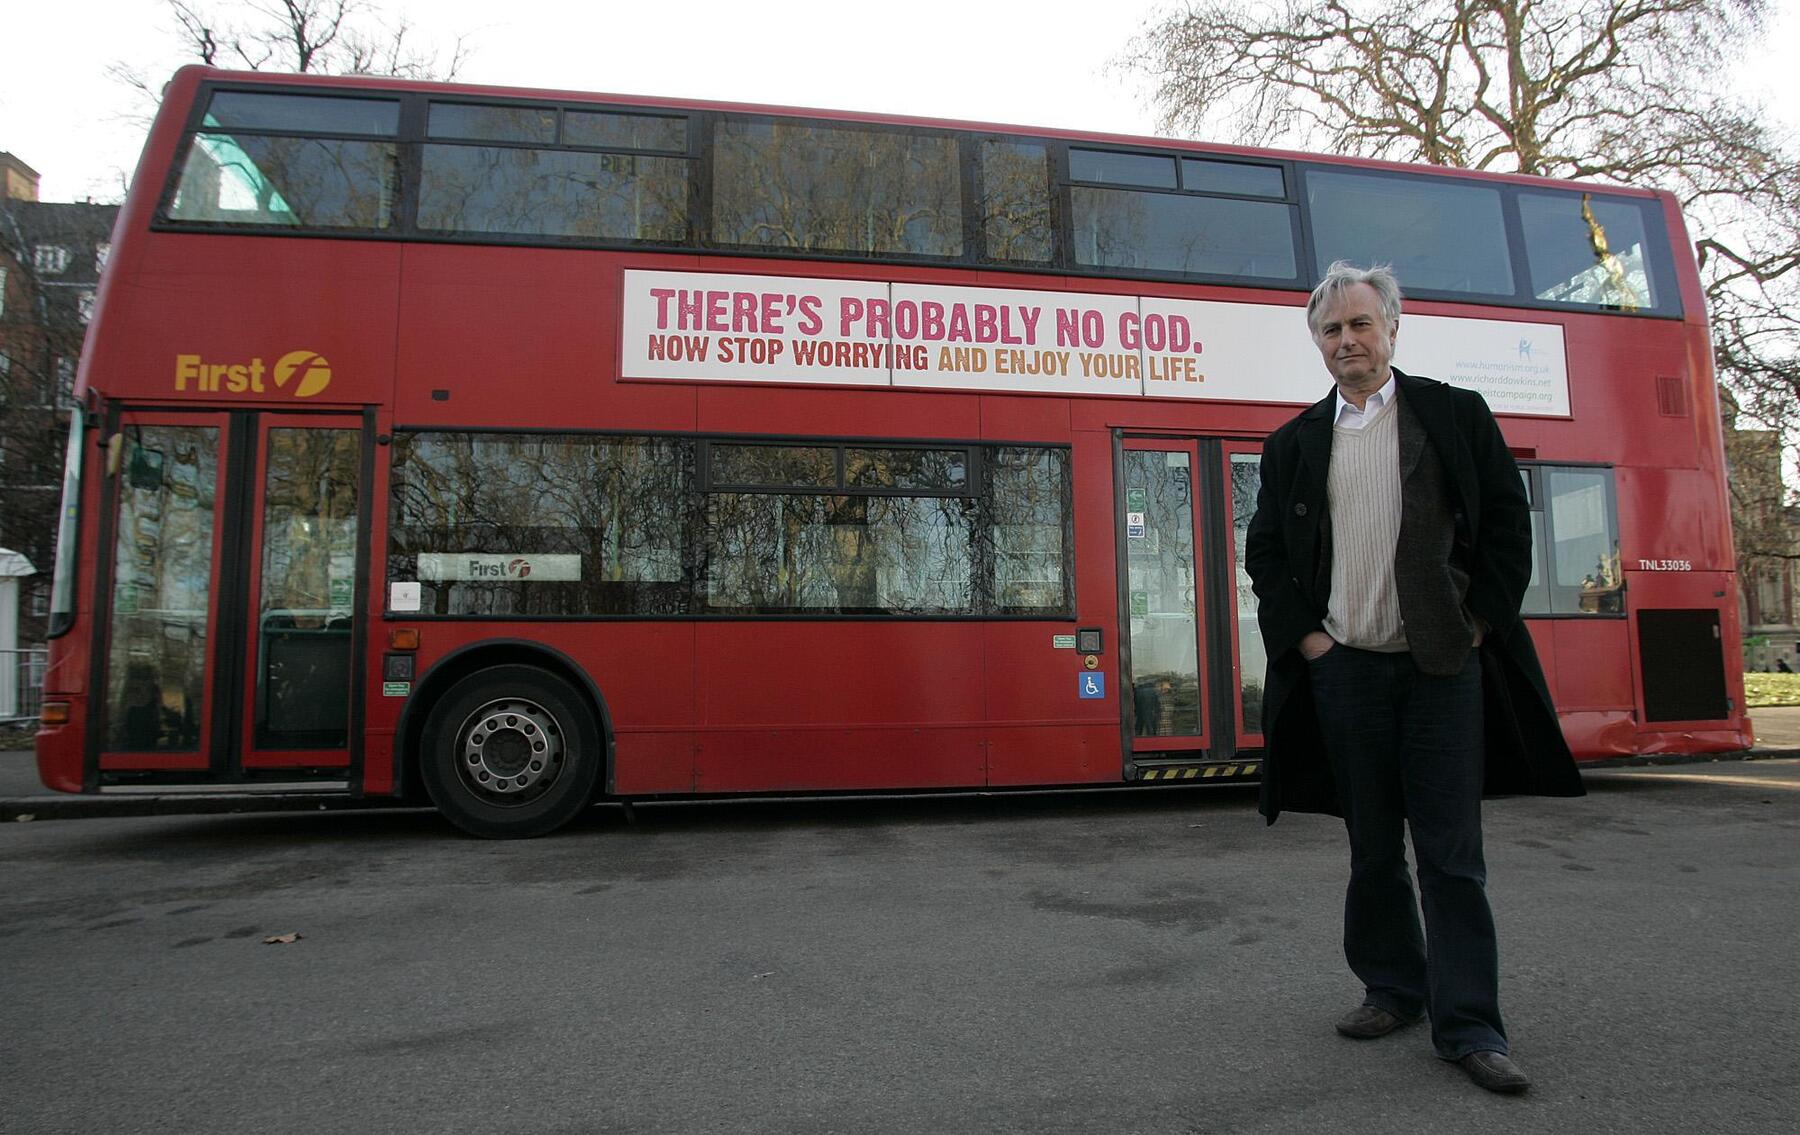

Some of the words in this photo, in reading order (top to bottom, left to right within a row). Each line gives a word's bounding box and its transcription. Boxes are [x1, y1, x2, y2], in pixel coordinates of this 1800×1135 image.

[649, 288, 824, 337] THERE'S
[839, 297, 1042, 345] PROBABLY
[1055, 307, 1105, 349] NO
[1118, 311, 1204, 355] GOD.
[174, 354, 266, 393] First
[648, 333, 710, 363] NOW
[717, 336, 784, 365] STOP
[792, 339, 929, 371] WORRYING
[937, 346, 988, 373] AND
[994, 348, 1071, 377] ENJOY
[1079, 352, 1141, 380] YOUR
[1149, 356, 1205, 383] LIFE.
[469, 560, 507, 578] First
[1638, 559, 1692, 572] TNL33036
